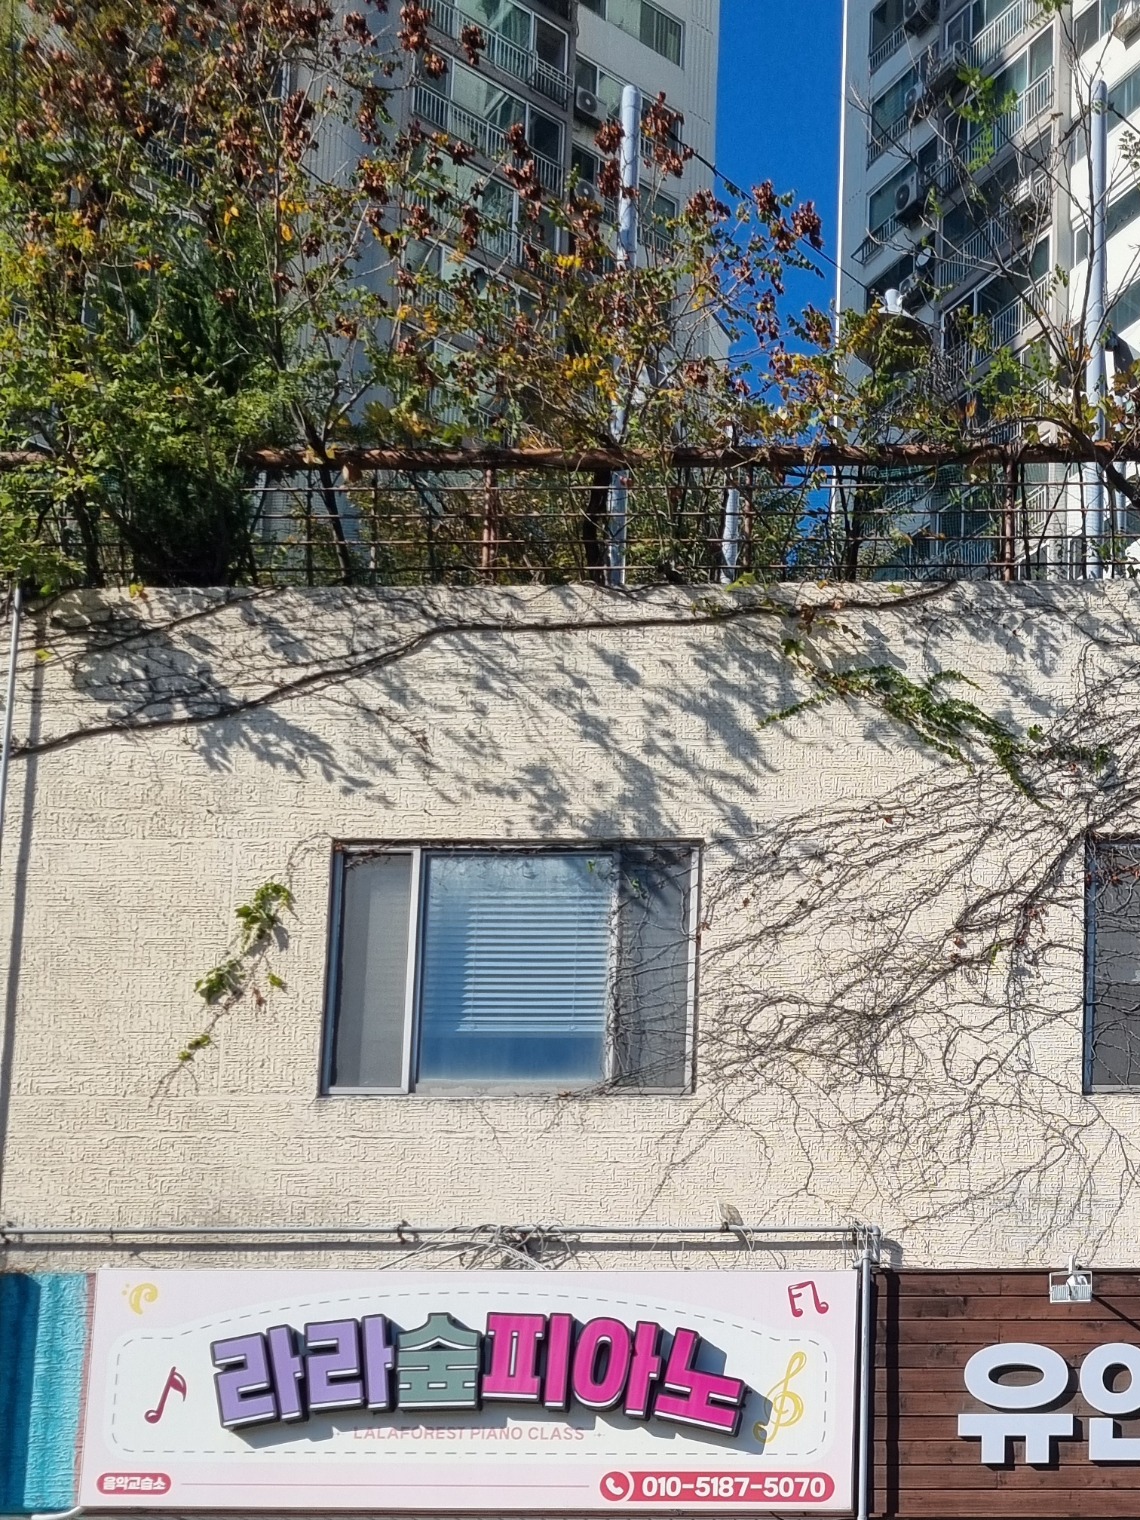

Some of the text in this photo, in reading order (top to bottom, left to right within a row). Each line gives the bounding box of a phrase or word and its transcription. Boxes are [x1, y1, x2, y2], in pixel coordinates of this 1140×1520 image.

[210, 1312, 745, 1437] 라라숲피아노
[353, 1426, 585, 1441] LALAFOREST PIANO CLASS
[102, 1476, 166, 1490] 음악교습소
[641, 1476, 826, 1498] 010-5187-5070
